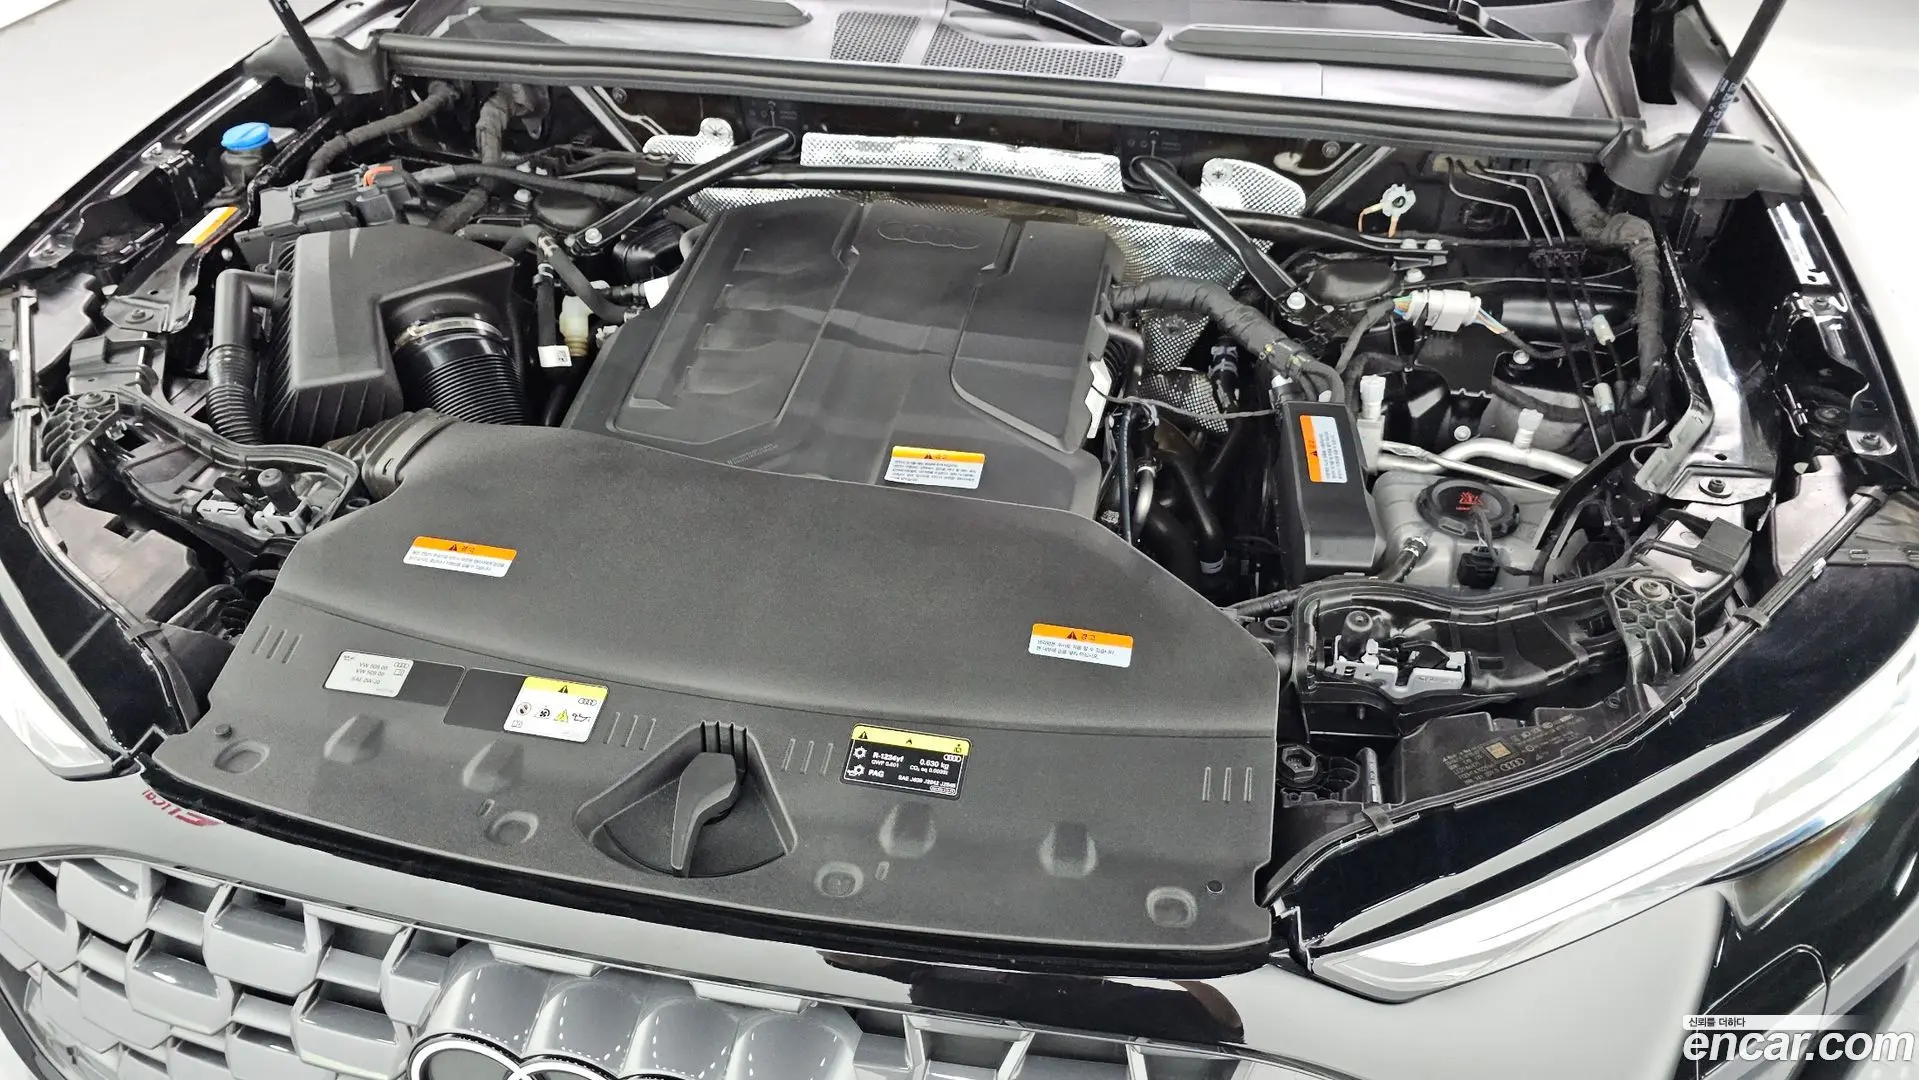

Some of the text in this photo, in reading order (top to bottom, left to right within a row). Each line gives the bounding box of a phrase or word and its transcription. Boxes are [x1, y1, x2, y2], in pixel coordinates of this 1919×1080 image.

[873, 751, 904, 762] R-1234yf
[920, 758, 950, 771] 0.630 kg
[868, 768, 885, 778] PAG
